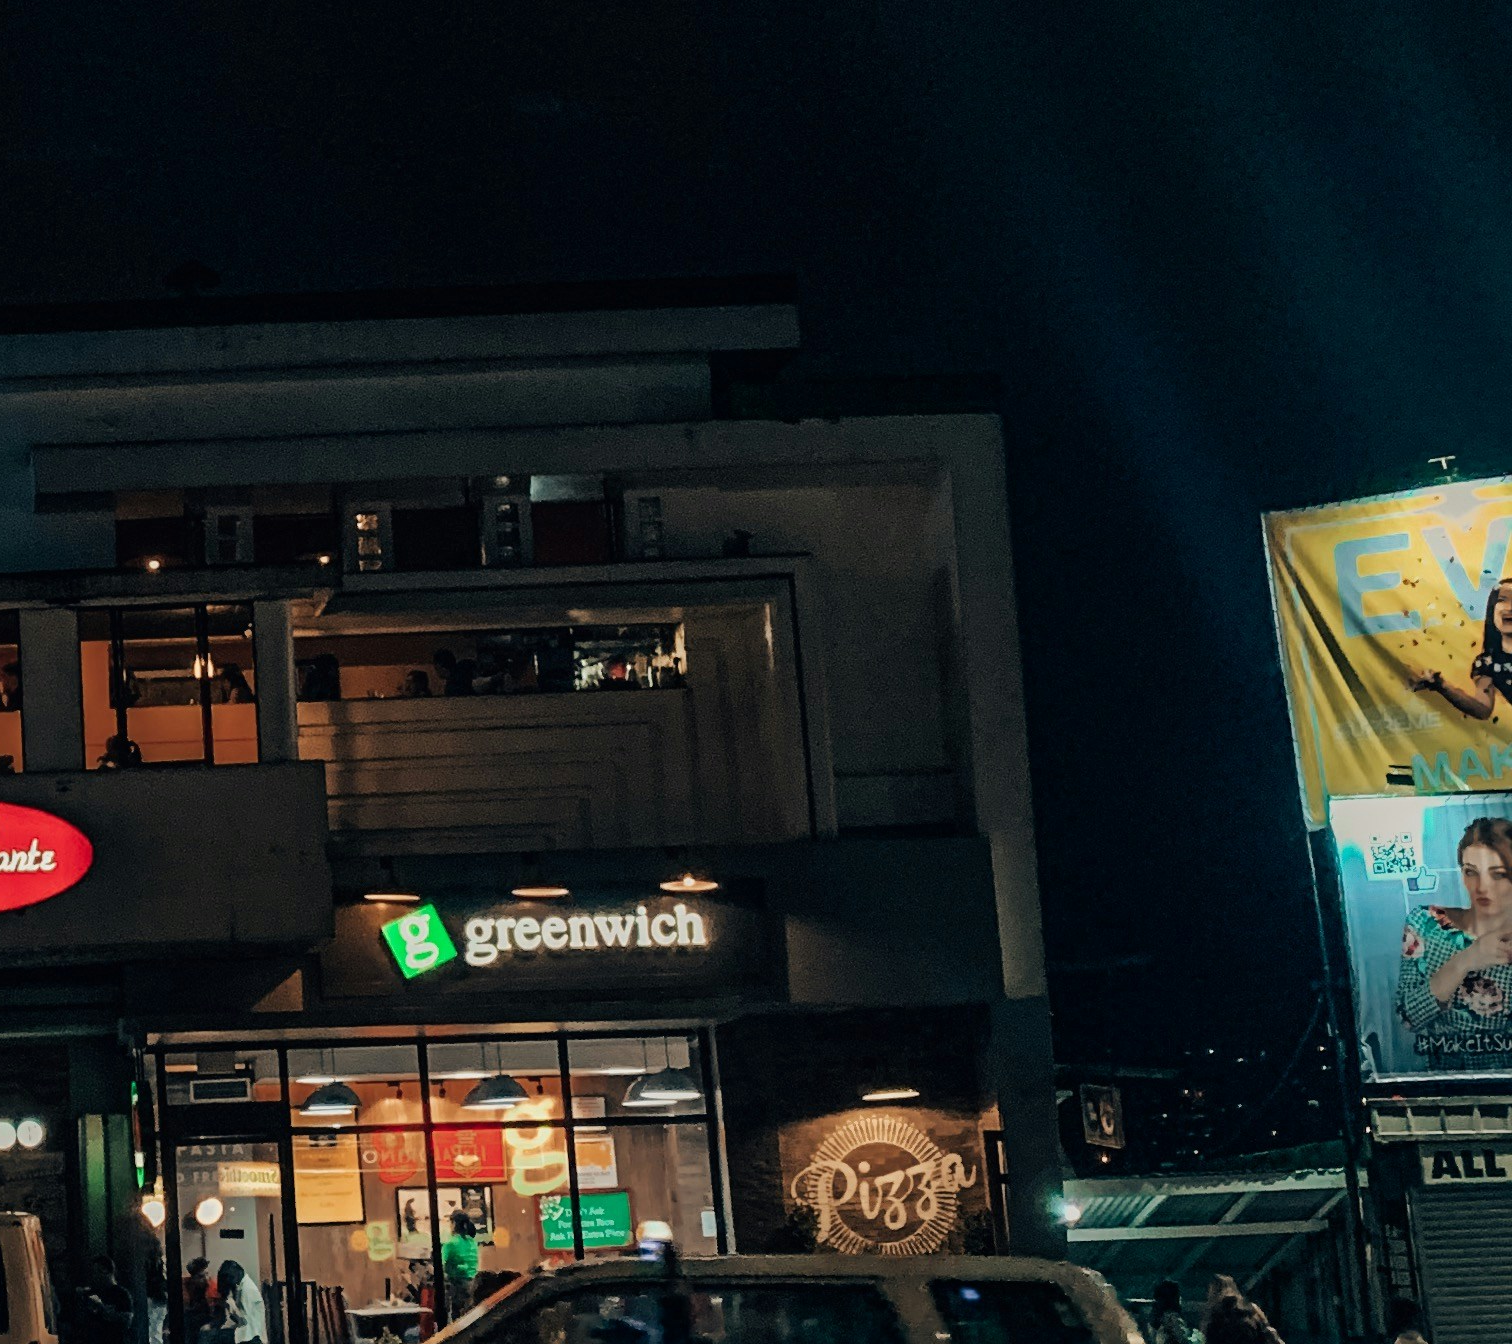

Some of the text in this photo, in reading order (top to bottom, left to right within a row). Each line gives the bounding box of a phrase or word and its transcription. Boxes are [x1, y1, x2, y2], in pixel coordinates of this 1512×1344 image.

[464, 903, 706, 968] greenwich
[1432, 1149, 1506, 1179] ALL
[791, 1152, 976, 1243] Pizza
